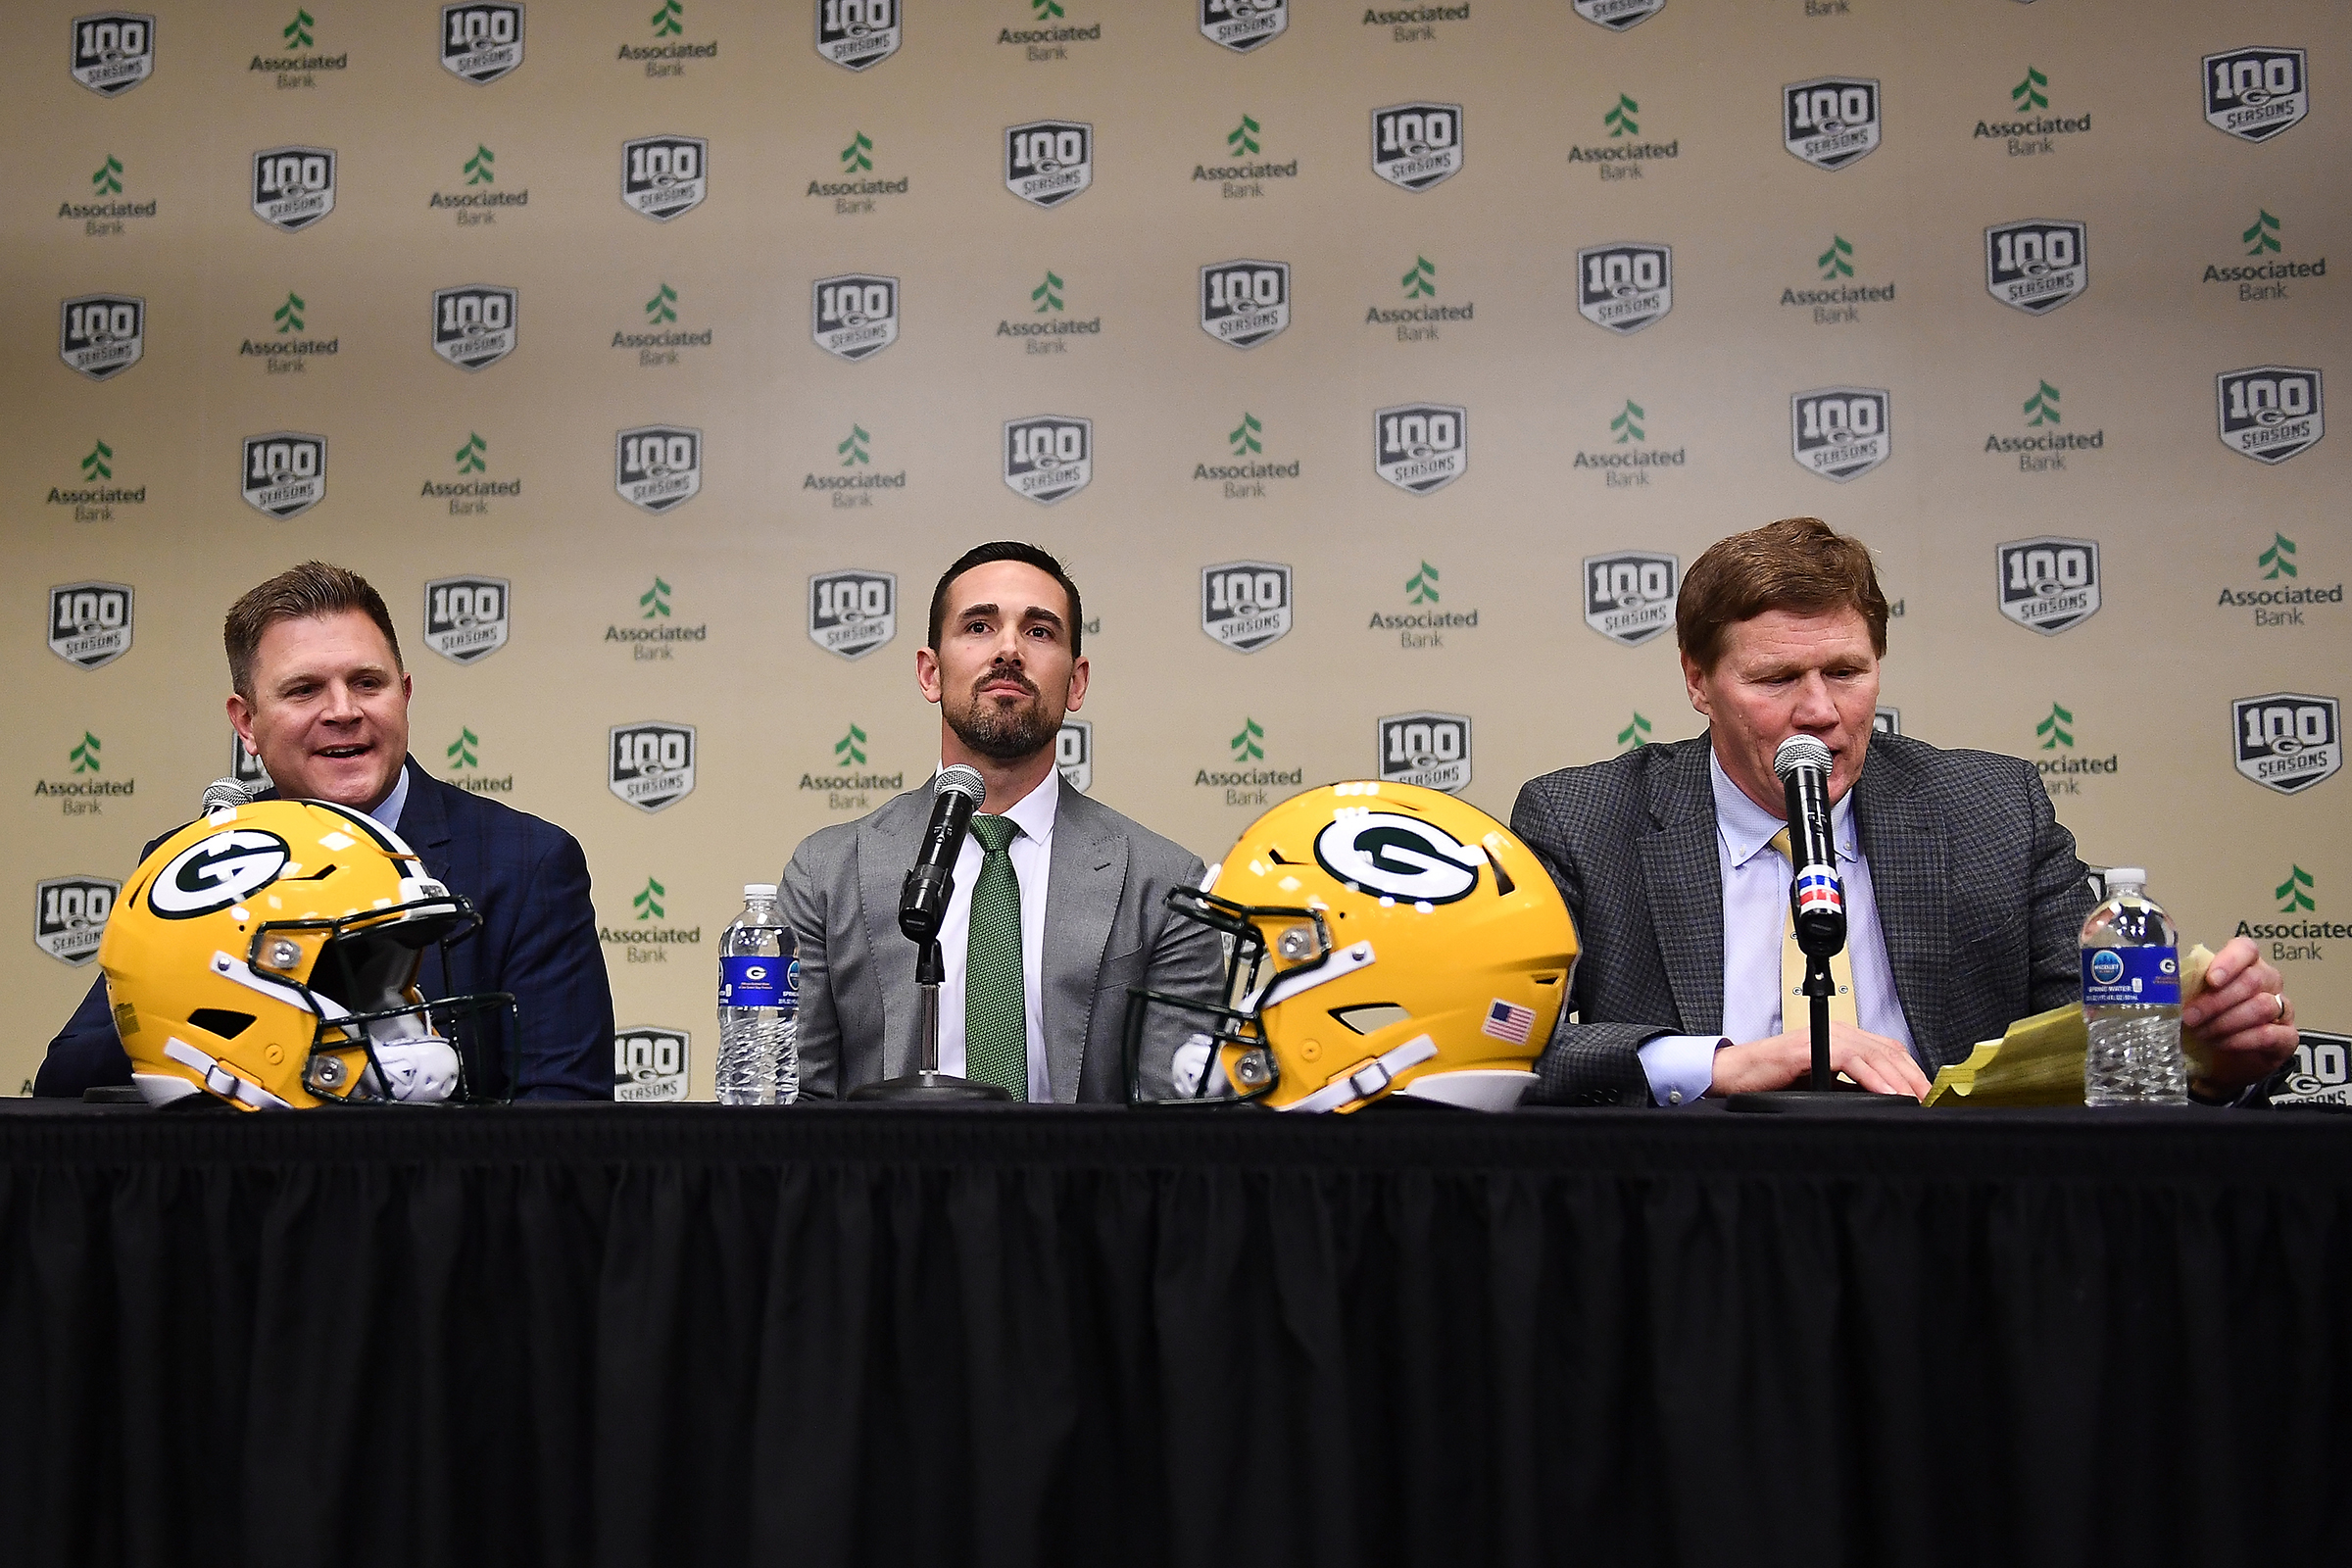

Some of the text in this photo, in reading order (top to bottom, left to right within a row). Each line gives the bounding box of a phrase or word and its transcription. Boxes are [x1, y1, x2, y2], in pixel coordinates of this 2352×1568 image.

[825, 0, 890, 32] 100
[1362, 2, 1470, 25] Associated
[450, 10, 514, 46] 100
[998, 23, 1101, 44] Associated
[1218, 14, 1276, 40] SEASONS
[1395, 24, 1436, 43] Bank
[80, 23, 144, 58] 100
[617, 40, 717, 60] Associated
[834, 33, 890, 59] SEASONS
[1028, 43, 1068, 62] Bank
[249, 52, 347, 72] Associated
[458, 48, 513, 72] SEASONS
[647, 60, 685, 77] Bank
[278, 72, 316, 89] Bank
[2215, 57, 2294, 100] 100
[1794, 87, 1868, 128] 100
[2227, 99, 2294, 128] SEASONS
[1382, 112, 1451, 151] 100
[1974, 113, 2091, 138] Associated
[1014, 130, 1081, 169] 100
[1568, 139, 1679, 163] Associated
[1805, 128, 1868, 157] SEASONS
[2009, 136, 2054, 157] Bank
[262, 157, 325, 192] 100
[632, 146, 696, 182] 100
[1192, 159, 1298, 181] Associated
[1392, 152, 1450, 178] SEASONS
[1600, 162, 1643, 180] Bank
[807, 176, 908, 196] Associated
[1023, 170, 1080, 195] SEASONS
[1223, 180, 1264, 199] Bank
[429, 188, 528, 208] Associated
[640, 184, 695, 209] SEASONS
[837, 197, 876, 215] Bank
[58, 200, 157, 218] Associated
[458, 209, 496, 226] Bank
[87, 220, 124, 236] Bank
[1997, 230, 2074, 271] 100
[1589, 253, 1660, 293] 100
[2203, 258, 2327, 282] Associated
[1210, 270, 1278, 309] 100
[1780, 282, 1895, 306] Associated
[2009, 272, 2074, 300] SEASONS
[2240, 281, 2288, 302] Bank
[442, 296, 507, 331] 100
[822, 284, 888, 321] 100
[1365, 302, 1474, 323] Associated
[1598, 294, 1660, 320] SEASONS
[1815, 305, 1859, 324] Bank
[70, 305, 134, 340] 100
[997, 317, 1101, 336] Associated
[1219, 310, 1278, 336] SEASONS
[1397, 323, 1440, 342] Bank
[239, 337, 338, 356] Associated
[450, 334, 505, 358] SEASONS
[611, 328, 711, 348] Associated
[830, 323, 887, 349] SEASONS
[1027, 337, 1067, 355] Bank
[269, 357, 306, 373] Bank
[641, 349, 679, 367] Bank
[2229, 377, 2310, 419] 100
[1803, 398, 1878, 438] 100
[1013, 426, 1080, 464] 100
[1385, 415, 1454, 453] 100
[1984, 429, 2104, 452] Associated
[2241, 420, 2310, 449] SEASONS
[252, 443, 316, 479] 100
[625, 436, 691, 472] 100
[1573, 447, 1686, 468] Associated
[1814, 440, 1878, 467] SEASONS
[2020, 452, 2067, 472] Bank
[803, 470, 906, 490] Associated
[1022, 466, 1080, 491] SEASONS
[1193, 460, 1300, 480] Associated
[1395, 456, 1454, 481] SEASONS
[1606, 468, 1650, 488] Bank
[47, 485, 146, 504] Associated
[420, 478, 520, 497] Associated
[633, 476, 689, 500] SEASONS
[1225, 480, 1266, 499] Bank
[450, 498, 488, 515] Bank
[833, 491, 873, 509] Bank
[75, 505, 114, 522] Bank
[2009, 549, 2086, 590] 100
[1211, 572, 1280, 611] 100
[1593, 564, 1666, 602] 100
[2218, 584, 2343, 606] Associated
[59, 593, 122, 628] 100
[434, 587, 499, 623] 100
[818, 581, 885, 618] 100
[2021, 592, 2087, 619] SEASONS
[1221, 613, 1280, 639] SEASONS
[1368, 609, 1479, 629] Associated
[1605, 606, 1666, 631] SEASONS
[2256, 607, 2304, 626] Bank
[441, 626, 497, 651] SEASONS
[605, 623, 707, 642] Associated
[827, 621, 884, 646] SEASONS
[1401, 630, 1444, 649] Bank
[634, 643, 673, 661] Bank
[2244, 706, 2327, 747] 100
[619, 733, 685, 770] 100
[1390, 724, 1460, 762] 100
[2036, 754, 2117, 773] ociated
[2258, 751, 2328, 778] SEASONS
[34, 778, 134, 796] Associated
[627, 774, 683, 798] SEASONS
[799, 771, 903, 790] Associated
[1195, 766, 1302, 786] Associated
[2045, 777, 2081, 795] ank
[63, 798, 102, 815] Bank
[829, 791, 869, 809] Bank
[1227, 788, 1268, 806] Bank
[1315, 811, 1477, 903] G
[45, 888, 112, 925] 100
[600, 925, 700, 943] Associated
[627, 945, 666, 962] Bank
[2272, 941, 2323, 960] Bank
[615, 1037, 680, 1076] 100
